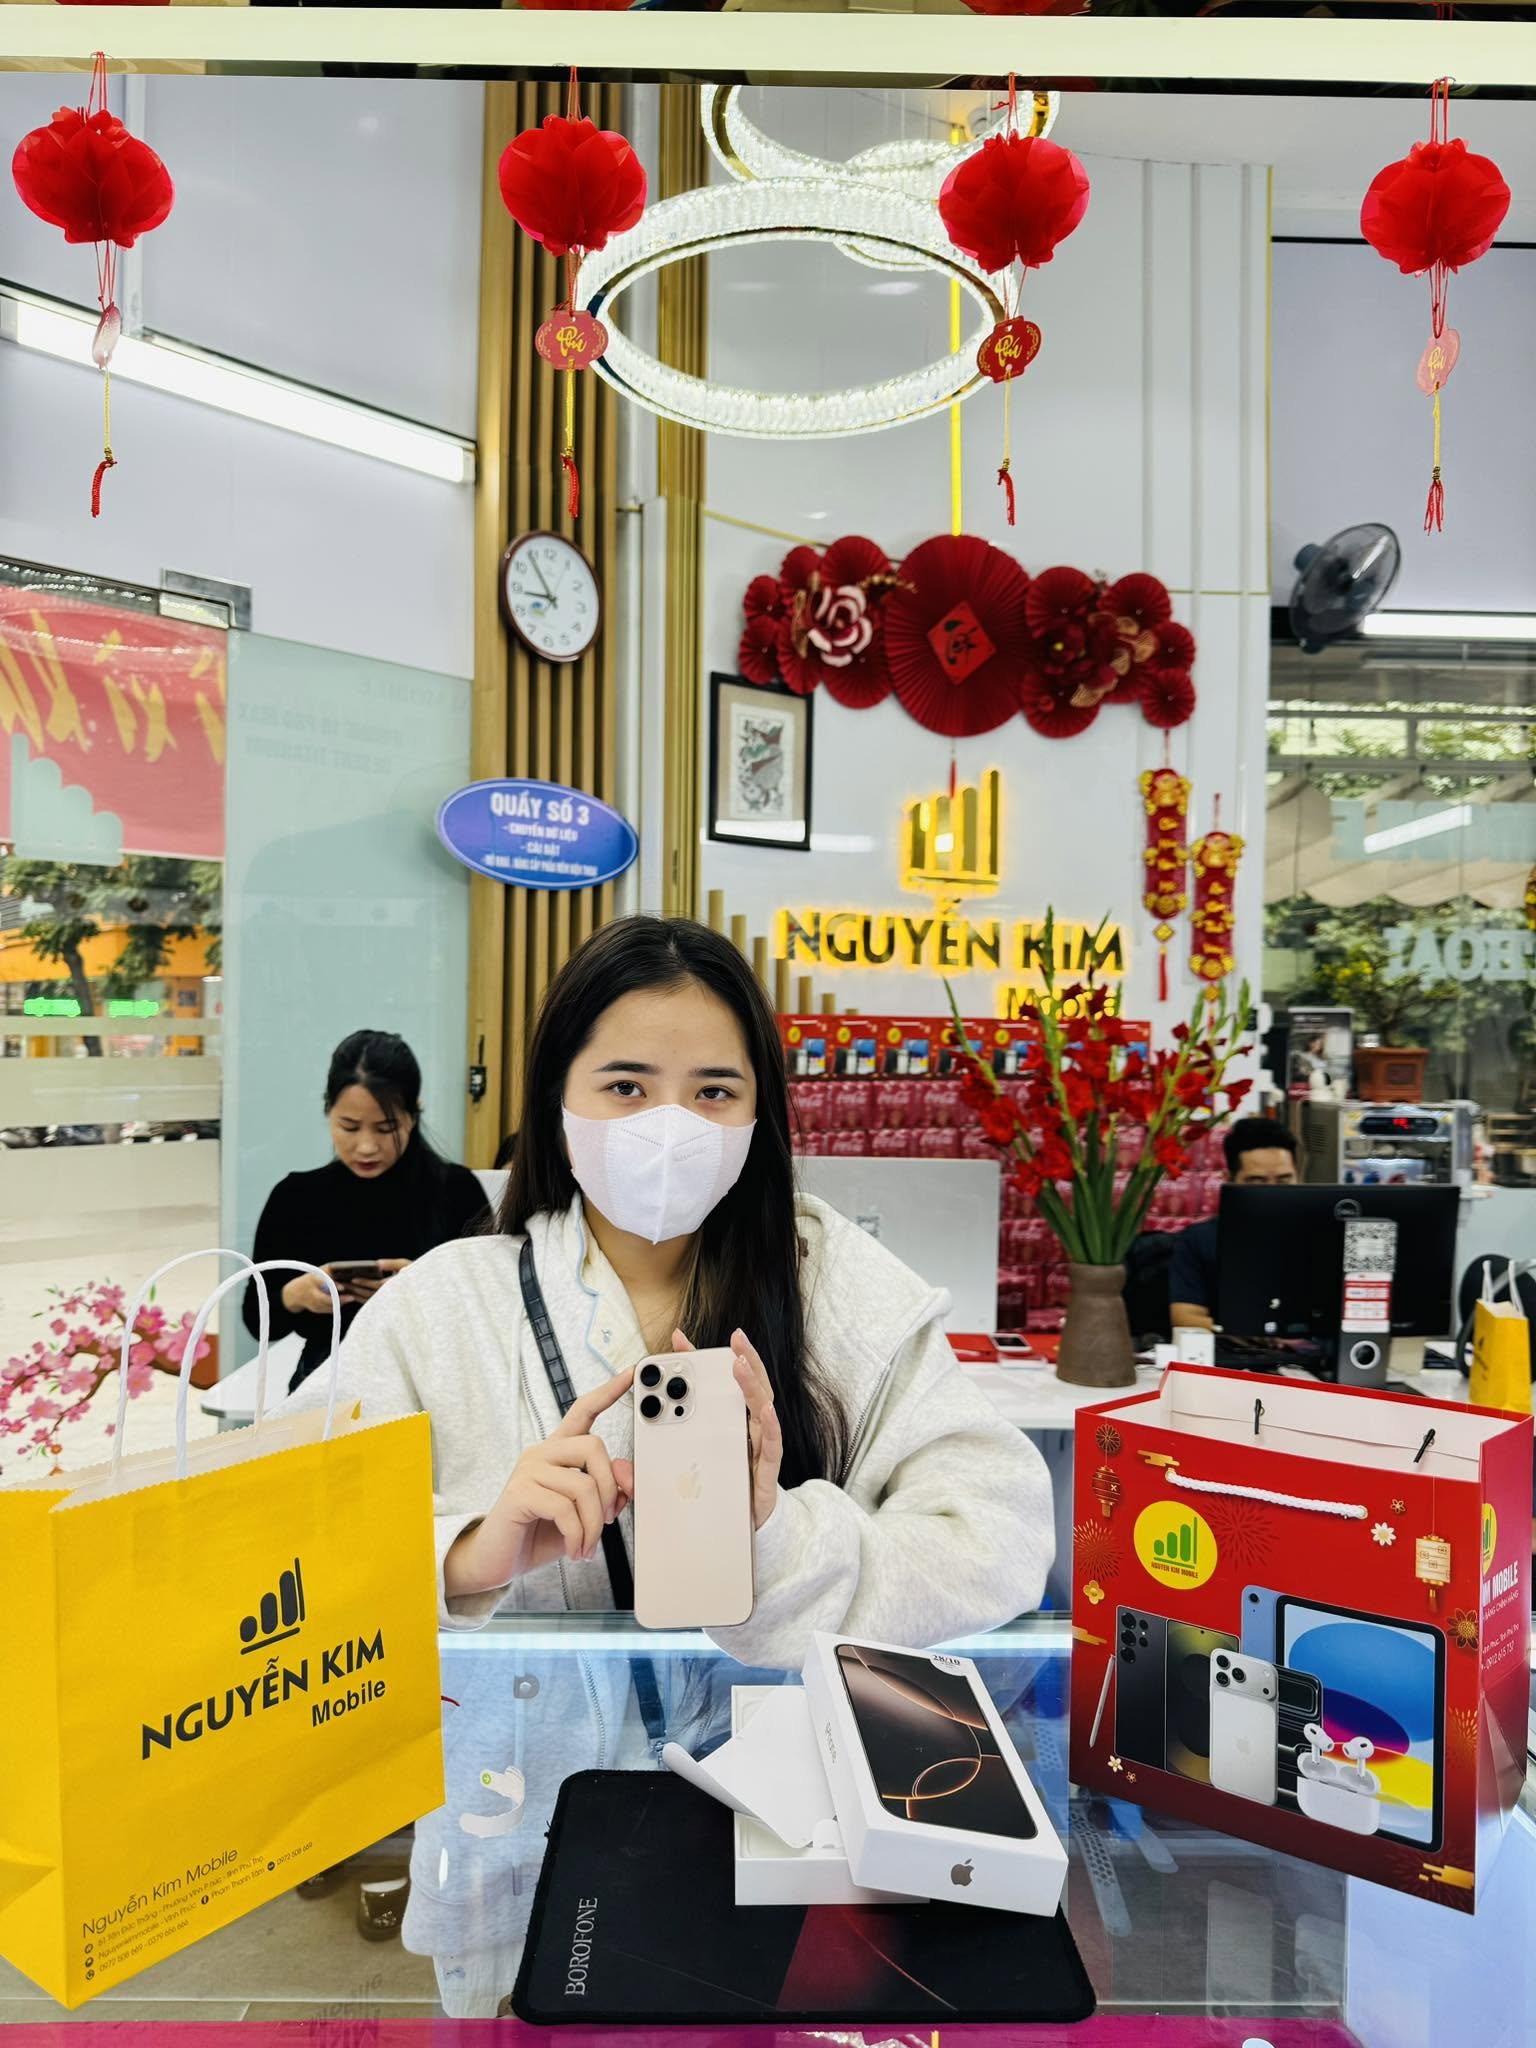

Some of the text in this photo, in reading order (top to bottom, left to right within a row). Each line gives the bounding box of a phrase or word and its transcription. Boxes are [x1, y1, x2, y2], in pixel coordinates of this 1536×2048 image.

[547, 797, 574, 824] SỐ
[577, 805, 590, 826] 3
[1013, 921, 1124, 971] KIM
[1492, 1560, 1519, 1601] MOBILE
[142, 1628, 385, 1761] NGUYỄN KIM
[312, 1680, 386, 1727] Mobile
[82, 1849, 239, 1938] Nguyễn Kim Mobile
[564, 1897, 598, 1995] BOROFONE
